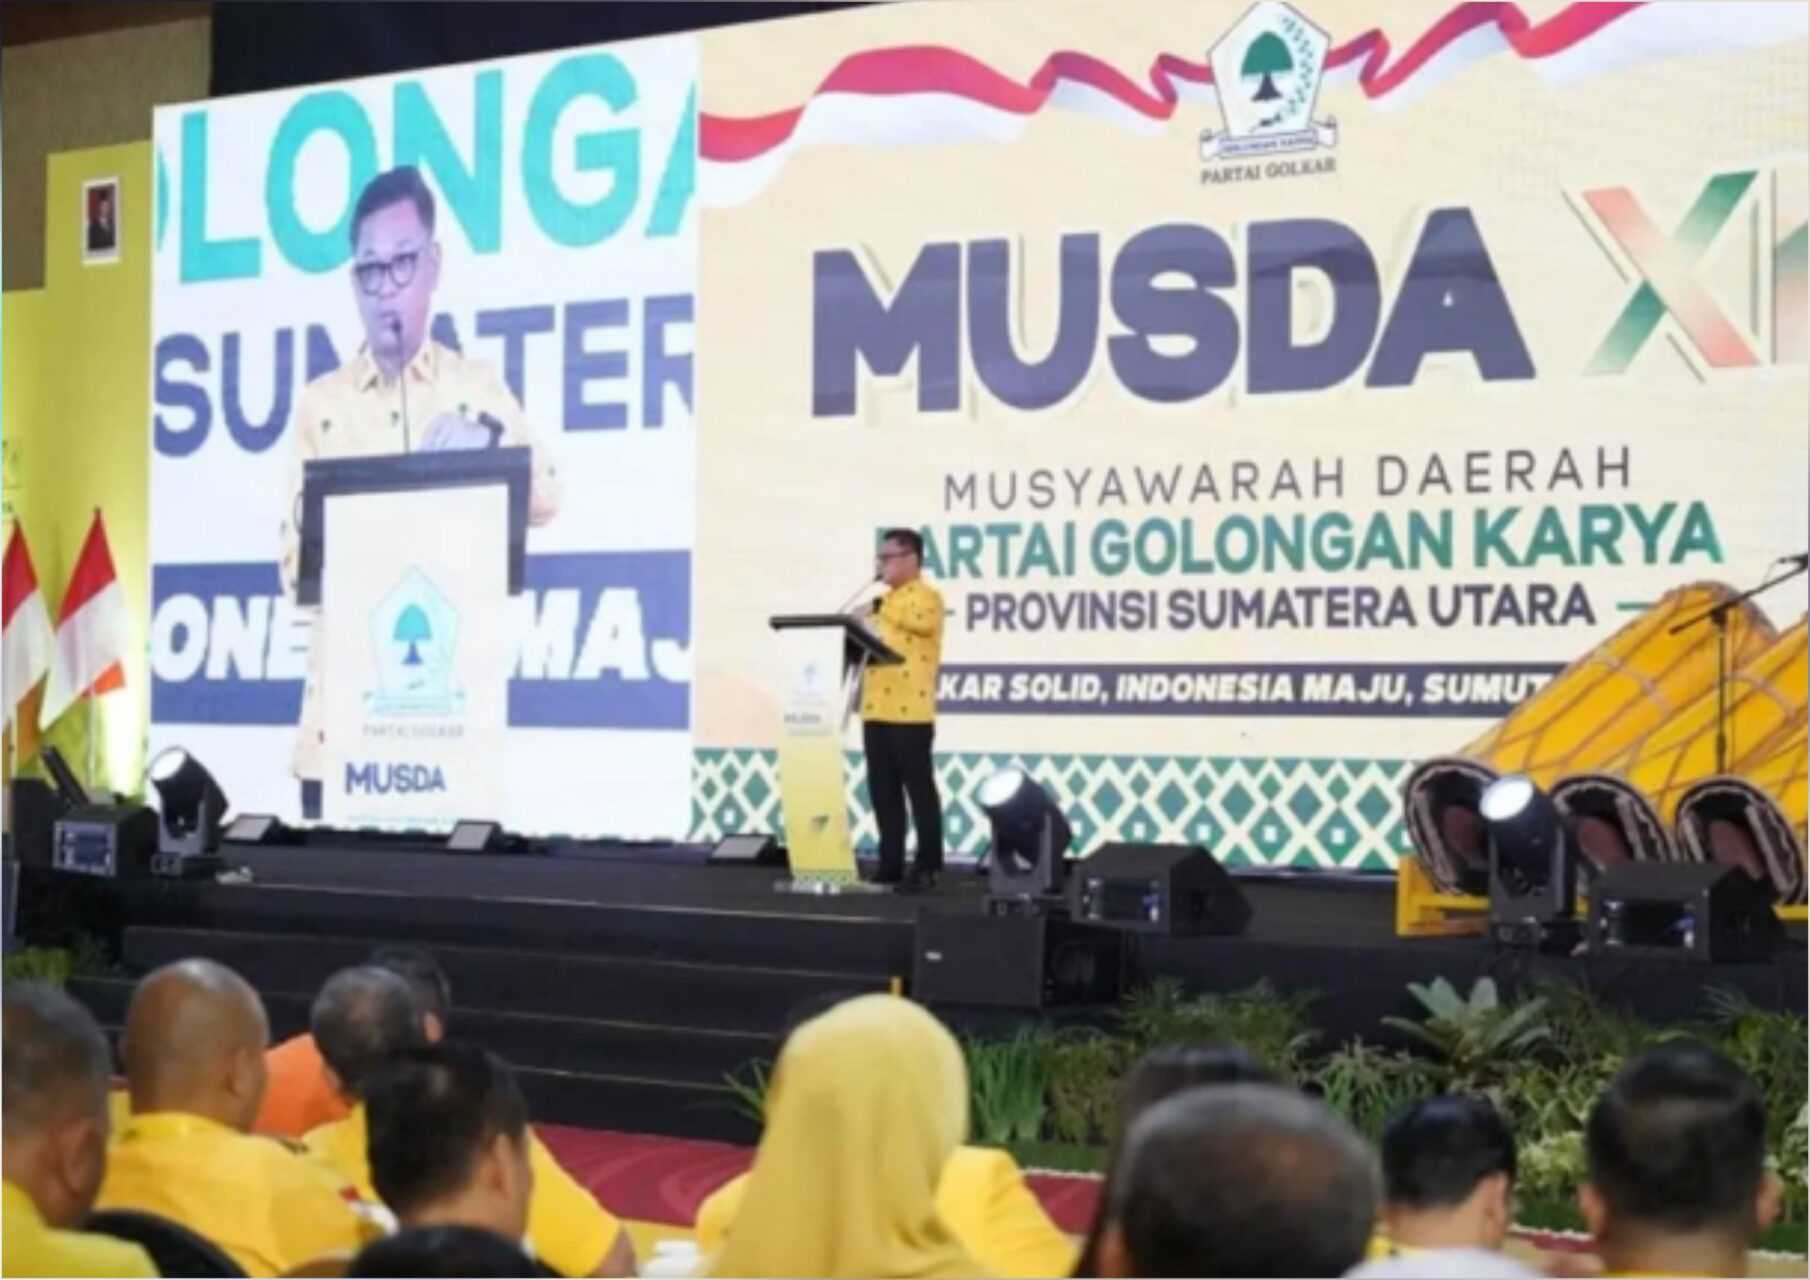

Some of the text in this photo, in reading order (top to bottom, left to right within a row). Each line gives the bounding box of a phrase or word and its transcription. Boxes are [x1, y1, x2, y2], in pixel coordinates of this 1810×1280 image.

[1201, 165, 1261, 184] PARTAI
[812, 207, 1537, 416] MUSDA
[943, 446, 1630, 510] MUSYAWARAH DAERAH
[1091, 509, 1452, 576] GOLONGAN
[1474, 501, 1723, 568] KARYA
[966, 583, 1596, 631] PROVINSI SUMATERA UTARA
[1009, 673, 1109, 706] SOLID,
[1115, 673, 1294, 703] INDONESIA
[1302, 673, 1413, 707] MAJU,
[344, 762, 446, 795] MUSDA
